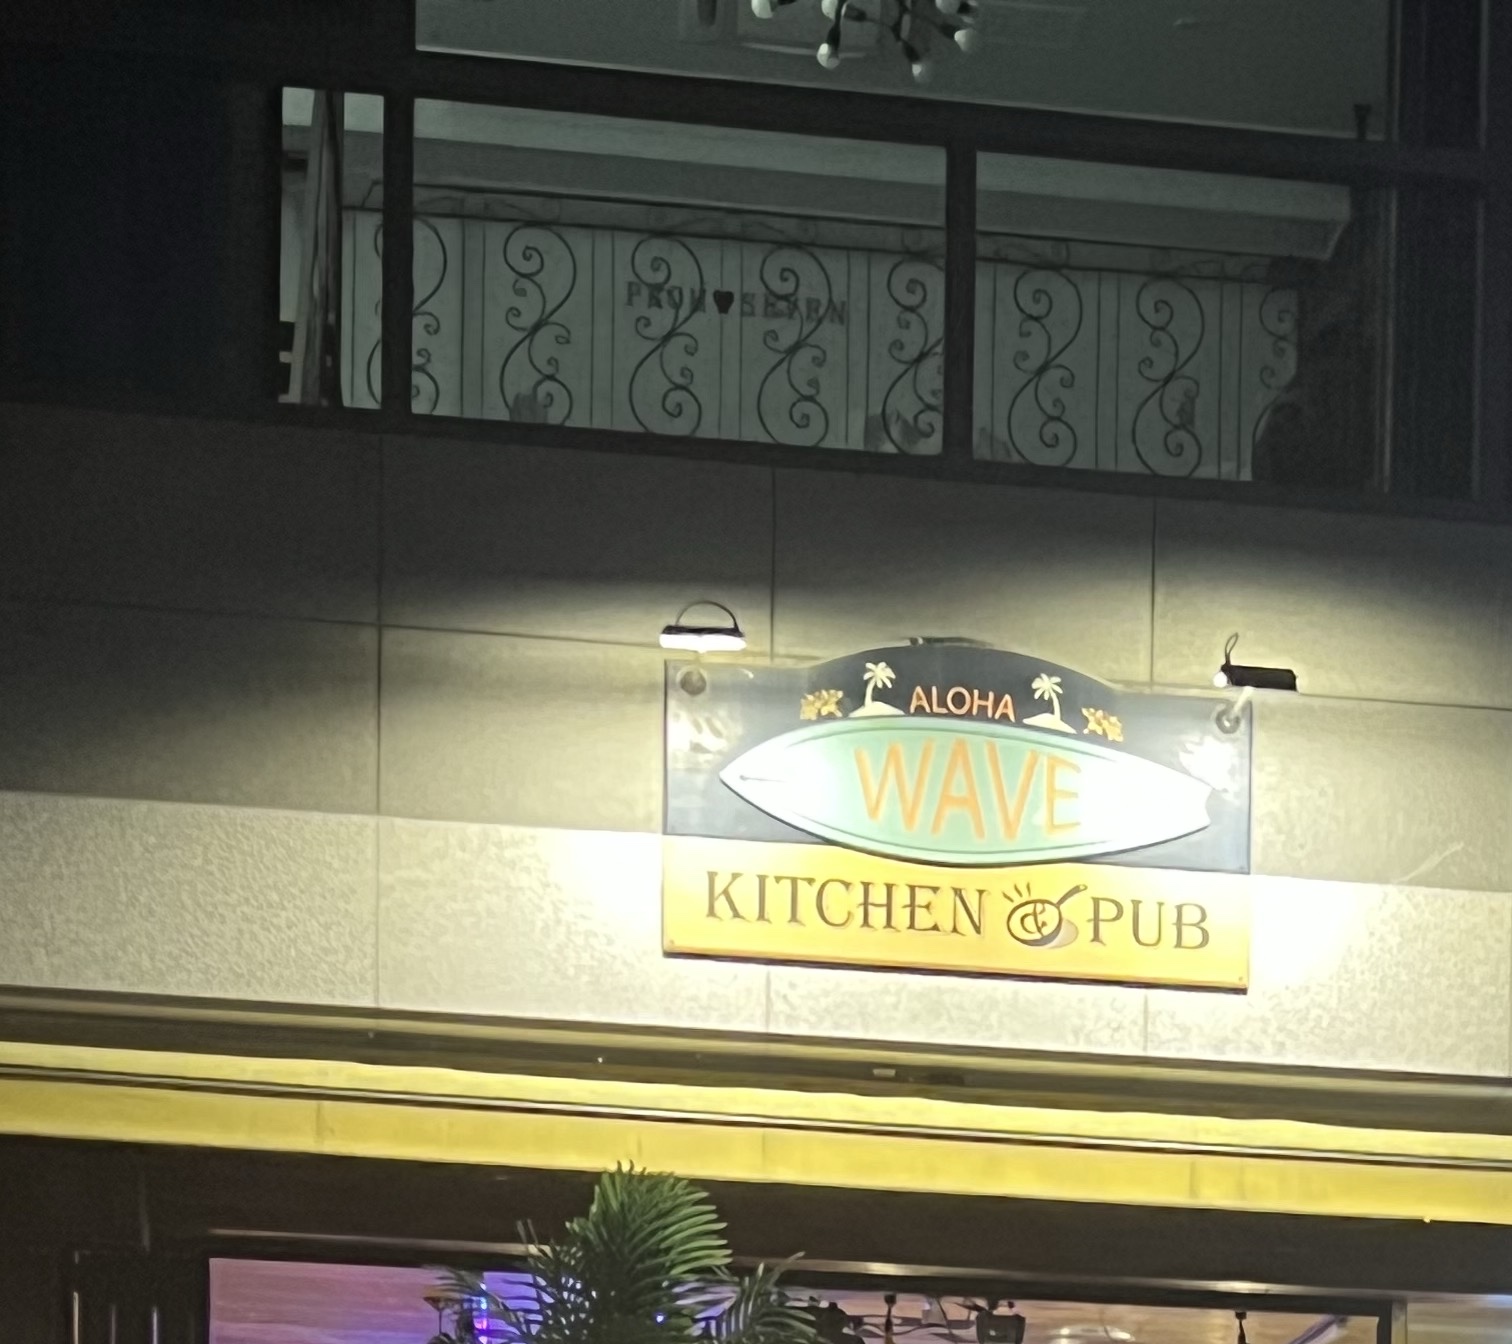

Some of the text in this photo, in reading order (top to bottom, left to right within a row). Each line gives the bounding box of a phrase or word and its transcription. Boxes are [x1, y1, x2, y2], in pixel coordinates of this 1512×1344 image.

[910, 685, 1016, 723] ALOHA
[854, 738, 1083, 841] WAVE
[705, 871, 987, 938] KITCHEN
[1089, 896, 1211, 951] PUB
